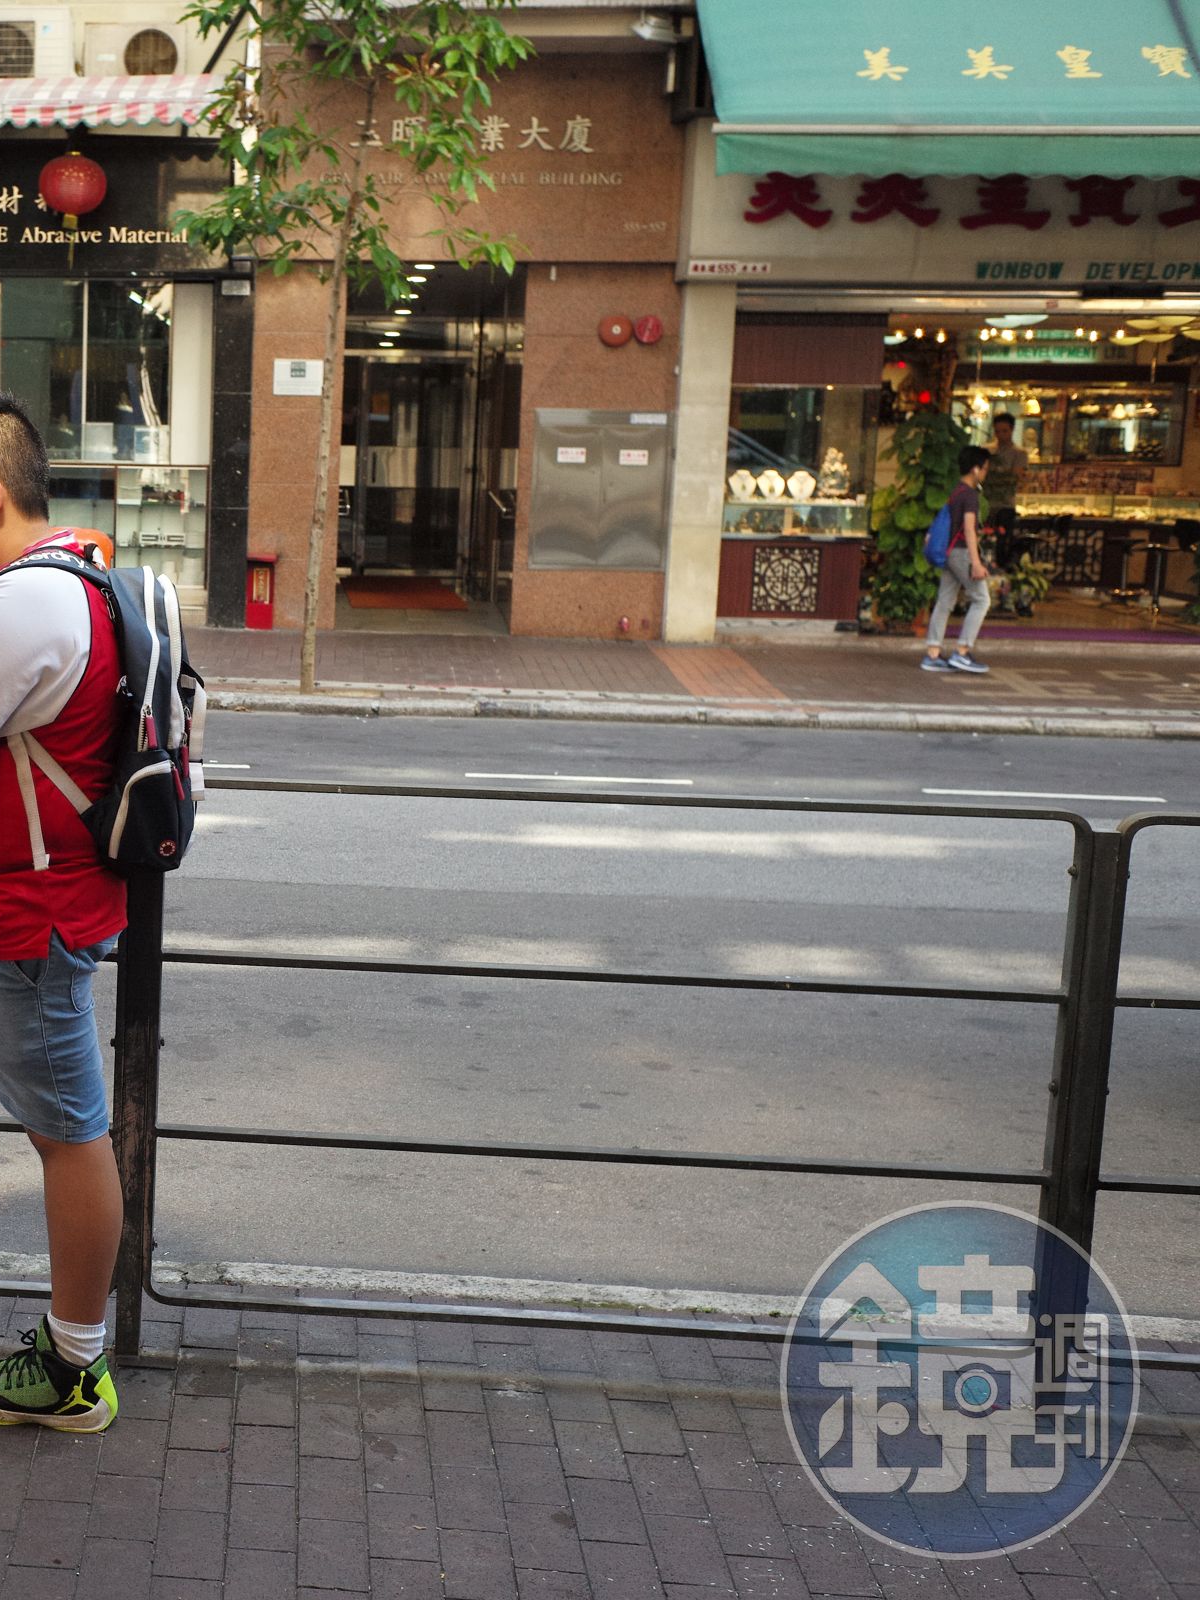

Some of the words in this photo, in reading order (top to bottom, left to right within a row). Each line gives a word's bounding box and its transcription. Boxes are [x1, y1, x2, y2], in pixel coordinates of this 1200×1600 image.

[539, 172, 622, 185] BUILDING
[20, 226, 103, 244] Abrasive
[976, 262, 1064, 280] WONBOW
